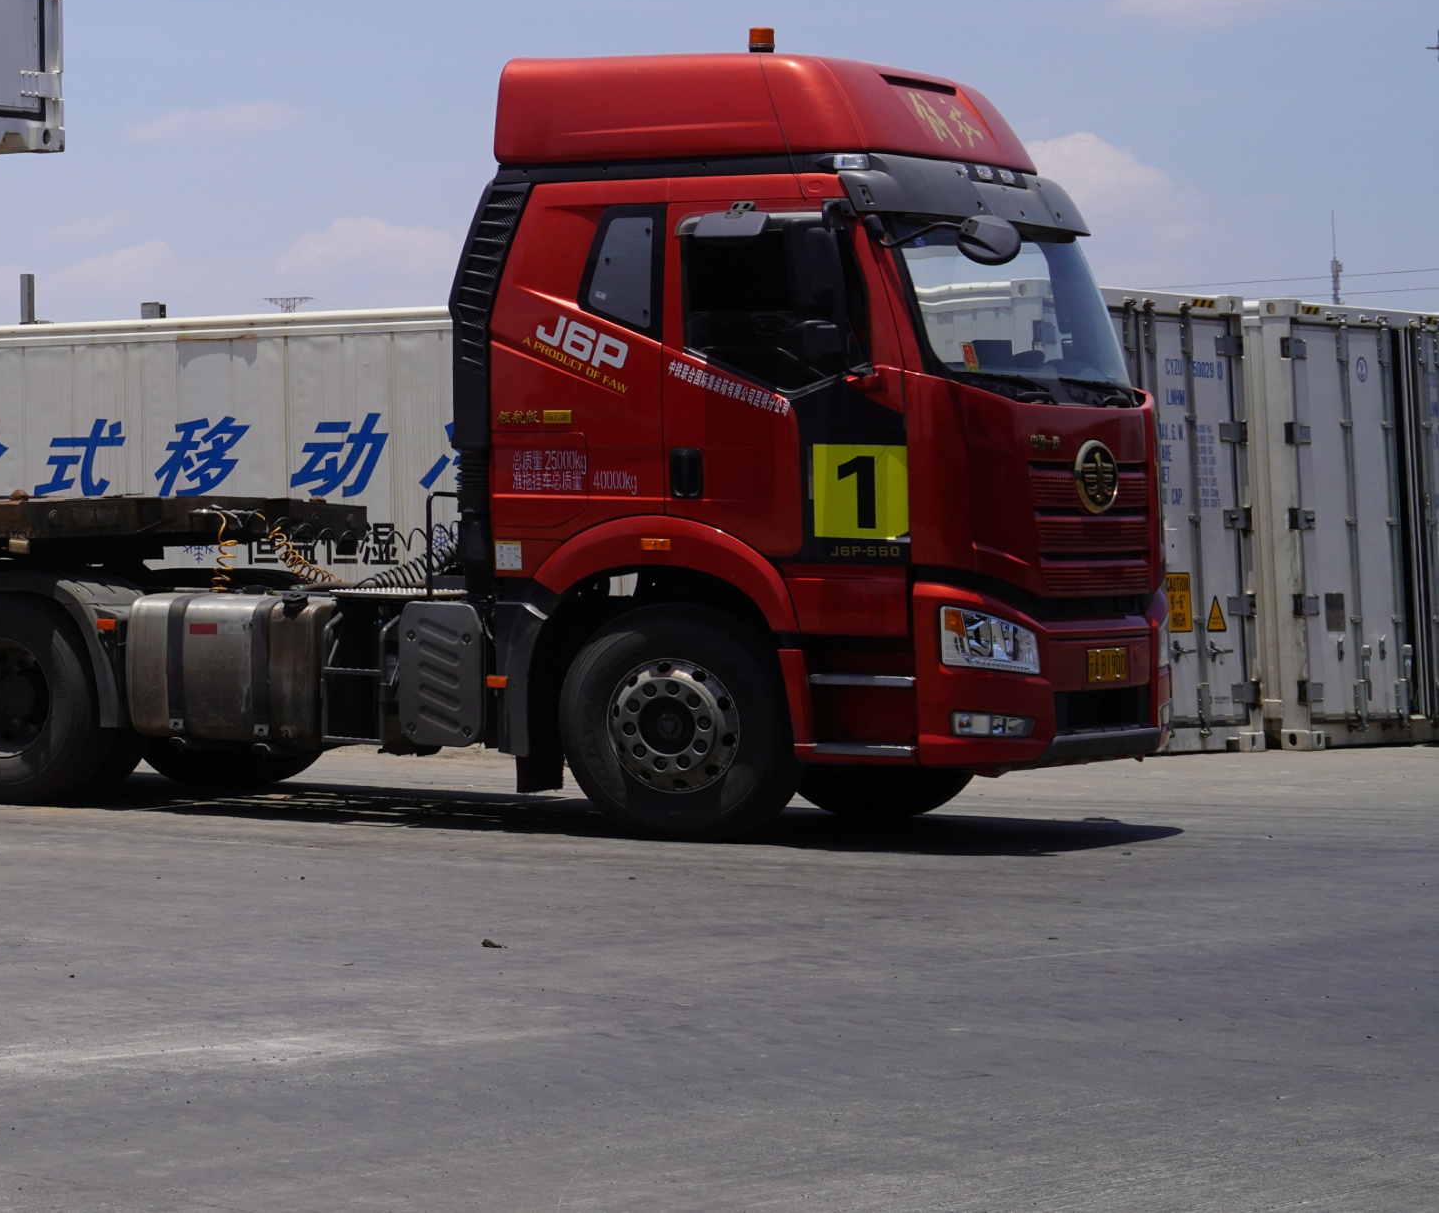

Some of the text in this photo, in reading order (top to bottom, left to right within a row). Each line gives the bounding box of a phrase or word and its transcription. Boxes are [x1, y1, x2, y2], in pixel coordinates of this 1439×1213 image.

[536, 315, 629, 369] J6P
[522, 336, 629, 394] A PRODUCT OF FAW
[1165, 358, 1183, 376] CYZU
[1193, 361, 1214, 379] 50029
[1166, 389, 1186, 407] LNHM
[497, 409, 541, 424] 领航版
[512, 450, 588, 475] 总质量 25000kg
[512, 470, 638, 495] 准拖挂车总质量 40000kg
[837, 455, 877, 530] 1
[831, 546, 900, 557] J6P-550
[1166, 577, 1189, 592] CAUTION
[1172, 613, 1186, 627] HIGH
